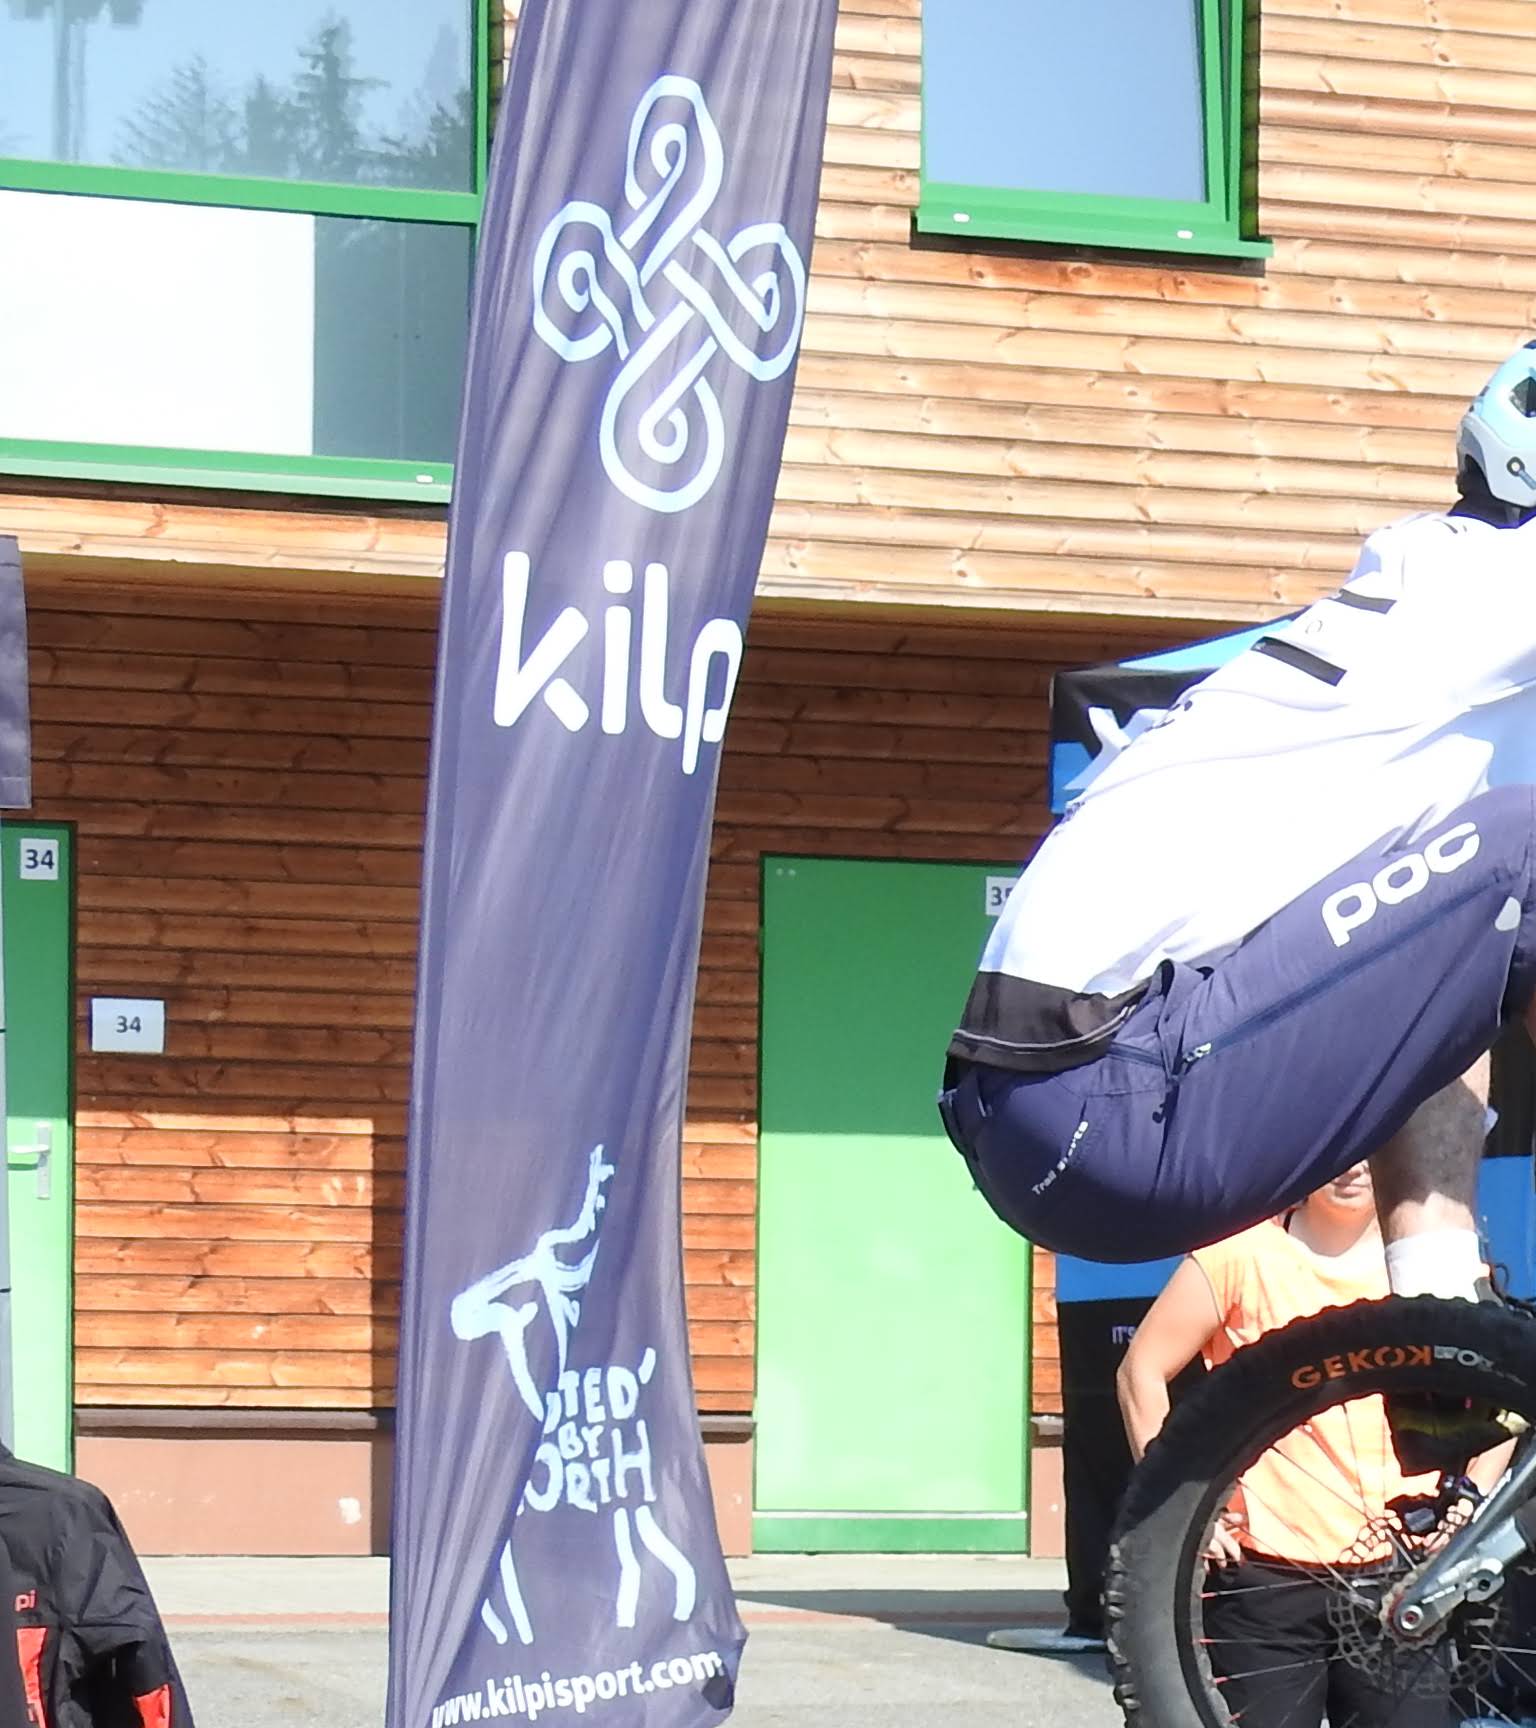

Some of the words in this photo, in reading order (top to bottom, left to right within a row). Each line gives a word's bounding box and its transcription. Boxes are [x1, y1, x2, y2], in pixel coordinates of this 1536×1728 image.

[25, 848, 55, 870] 34
[116, 1015, 142, 1033] 34
[557, 1421, 605, 1460] BY
[516, 1420, 657, 1516] ORTH
